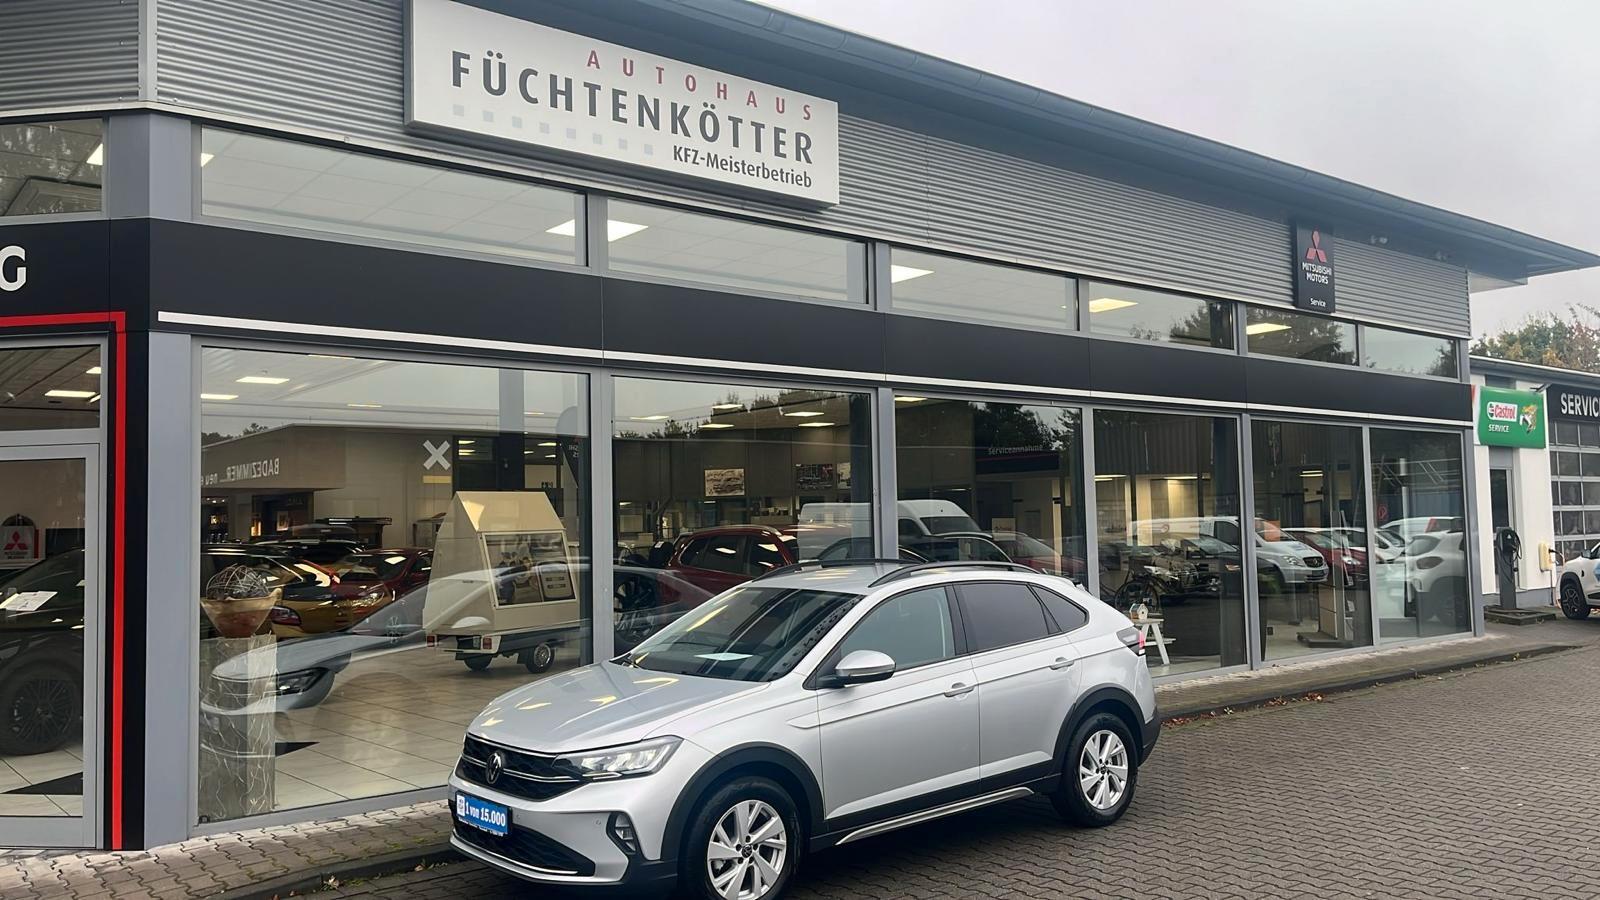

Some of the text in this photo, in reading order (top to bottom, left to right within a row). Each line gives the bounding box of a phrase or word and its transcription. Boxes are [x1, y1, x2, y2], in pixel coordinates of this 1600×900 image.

[586, 49, 812, 121] AUTOHAUS
[451, 49, 814, 165] FÜCHTENKÖTTER
[672, 144, 813, 189] KFZ-Meisterbetrieb
[1302, 262, 1332, 276] MITSUBISHI
[1306, 272, 1328, 284] MOTORS
[1310, 298, 1326, 307] Service
[1494, 404, 1516, 420] Castrol
[1560, 392, 1600, 418] SERVIC
[1488, 424, 1510, 432] SERVICE
[466, 802, 470, 814] 1
[470, 806, 480, 818] von
[480, 808, 505, 827] 15.000
